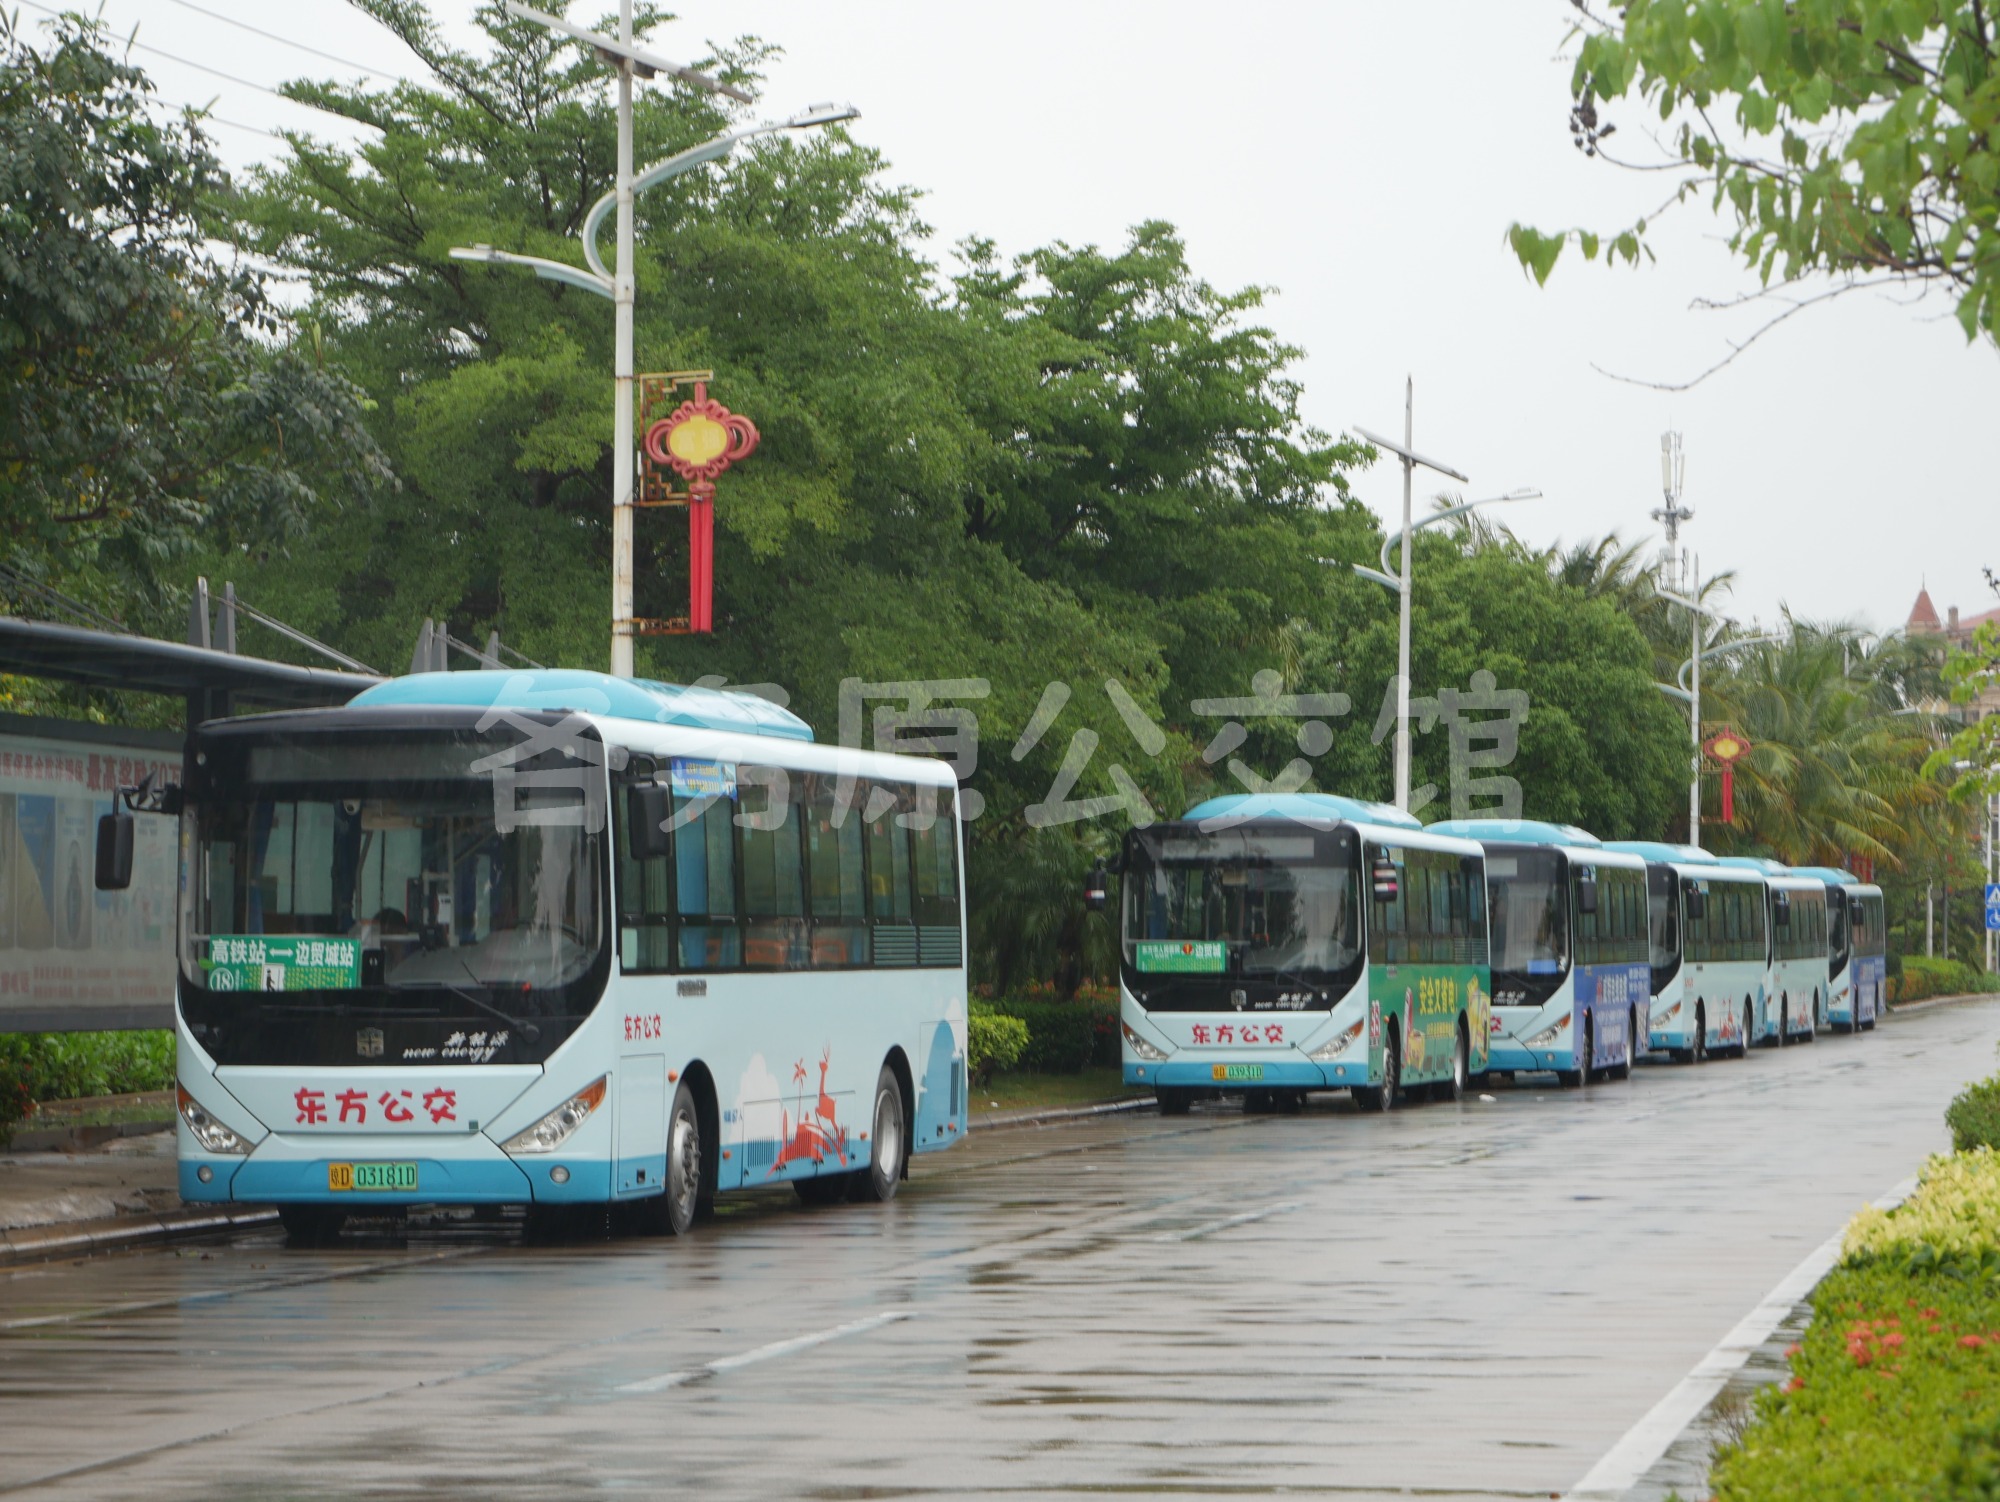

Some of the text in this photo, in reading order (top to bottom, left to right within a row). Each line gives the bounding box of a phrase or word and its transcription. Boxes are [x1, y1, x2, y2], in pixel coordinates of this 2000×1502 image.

[212, 939, 355, 968] 高铁站 边贸城站
[214, 972, 231, 991] 18
[624, 1012, 661, 1041] 东方公交
[1192, 1023, 1284, 1044] 东方公交
[294, 1087, 457, 1125] 东方公交
